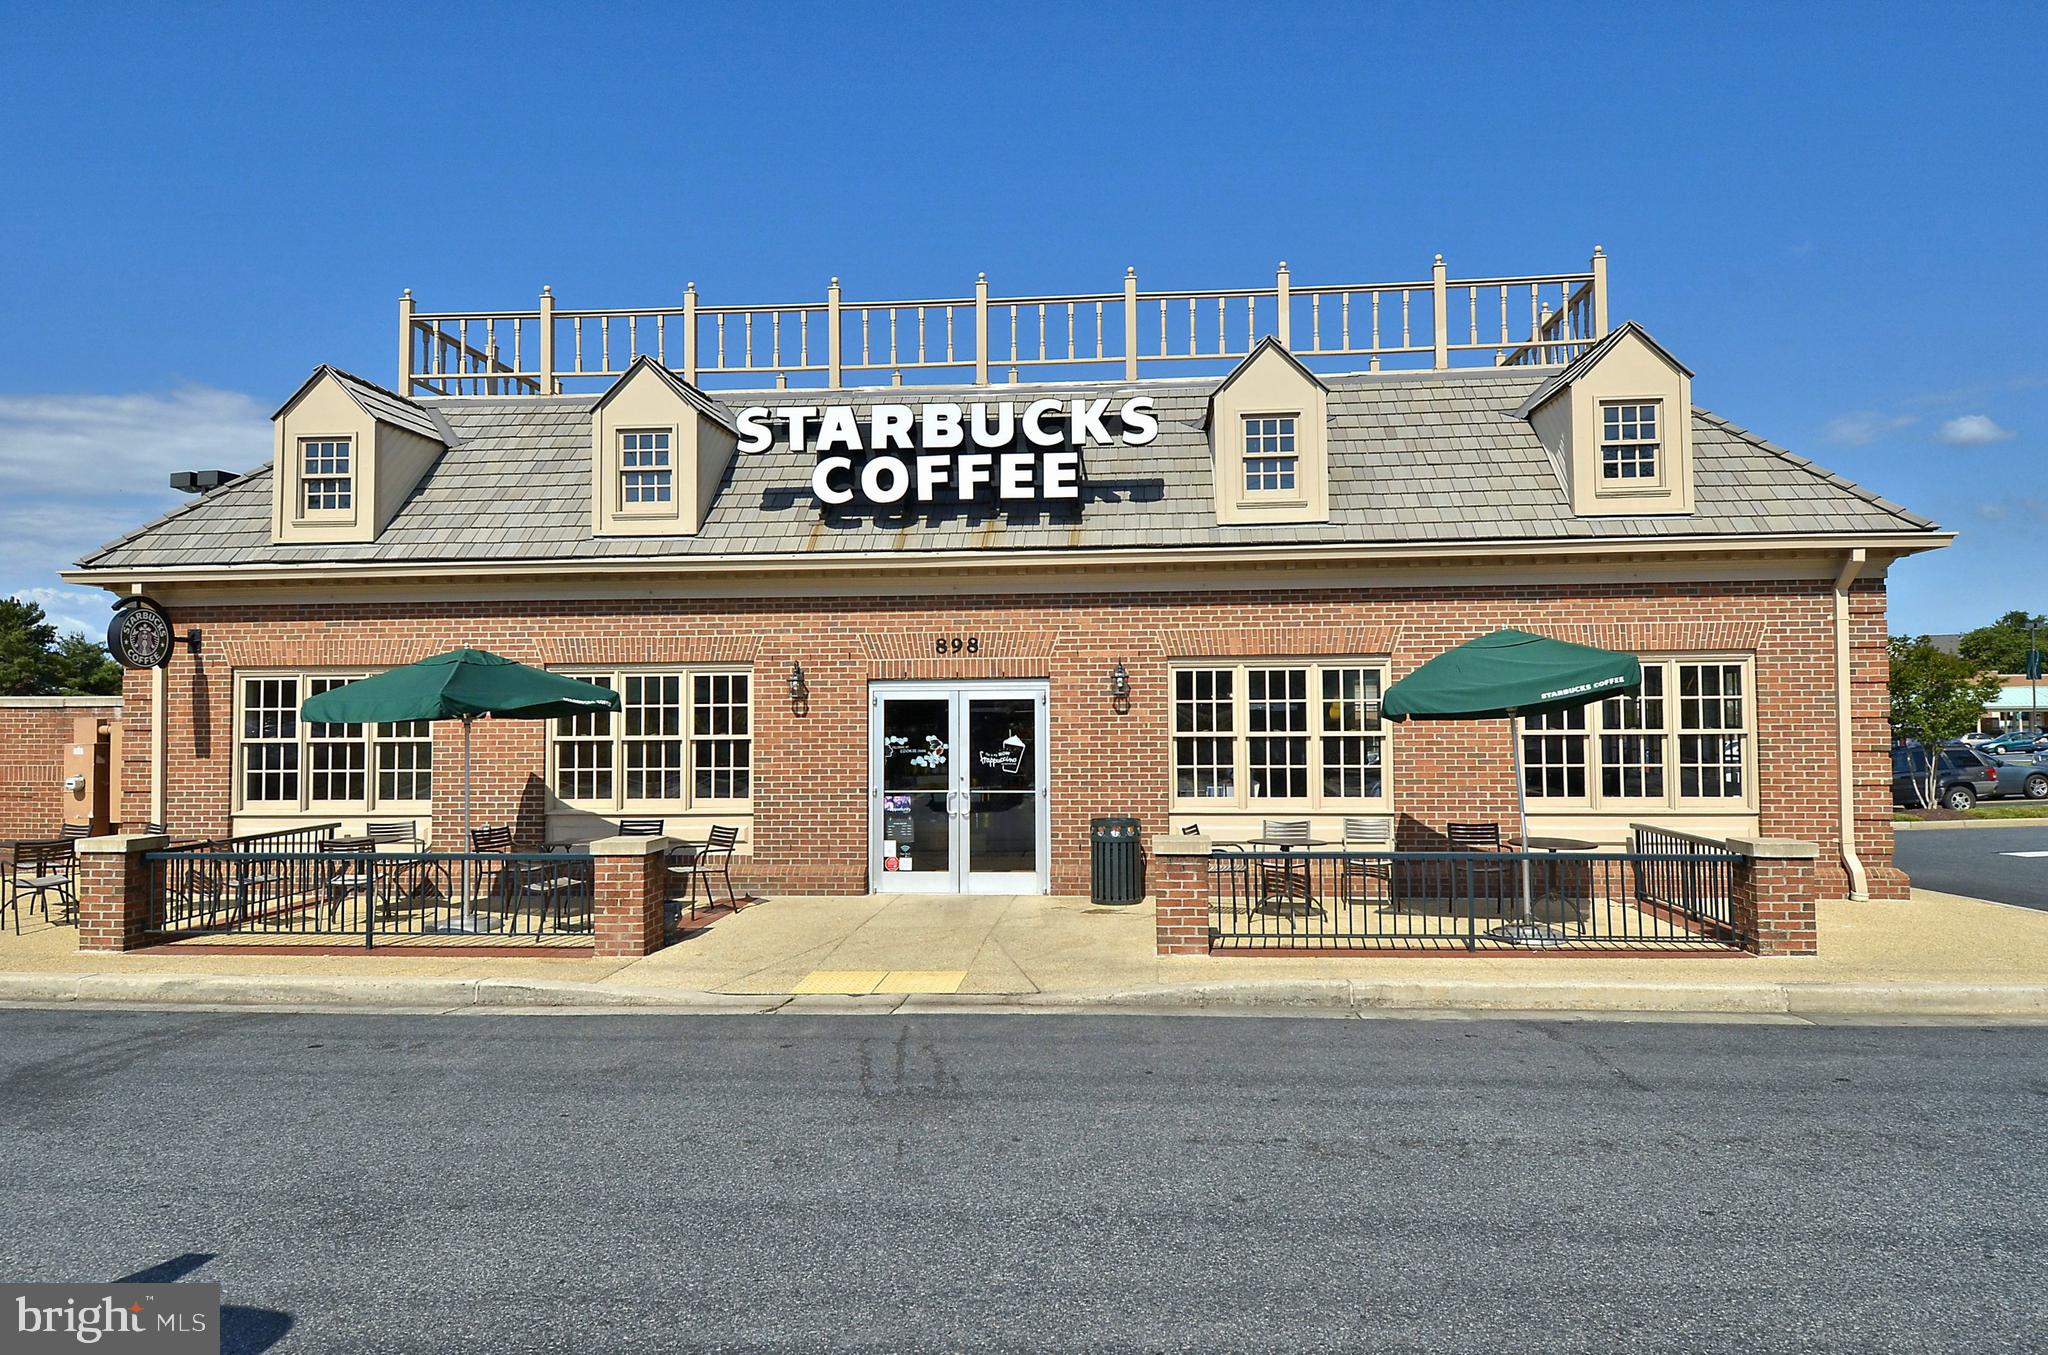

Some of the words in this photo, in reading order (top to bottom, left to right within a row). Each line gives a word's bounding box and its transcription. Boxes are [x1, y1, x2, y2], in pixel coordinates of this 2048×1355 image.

[736, 396, 1158, 453] STARBUCKS
[811, 452, 1079, 504] COFFEE
[123, 611, 167, 637] STARBUCKS
[127, 649, 160, 665] COFFEE
[936, 638, 978, 654] 898
[1541, 684, 1591, 699] STARBUCKS
[1593, 676, 1624, 689] COFFEE
